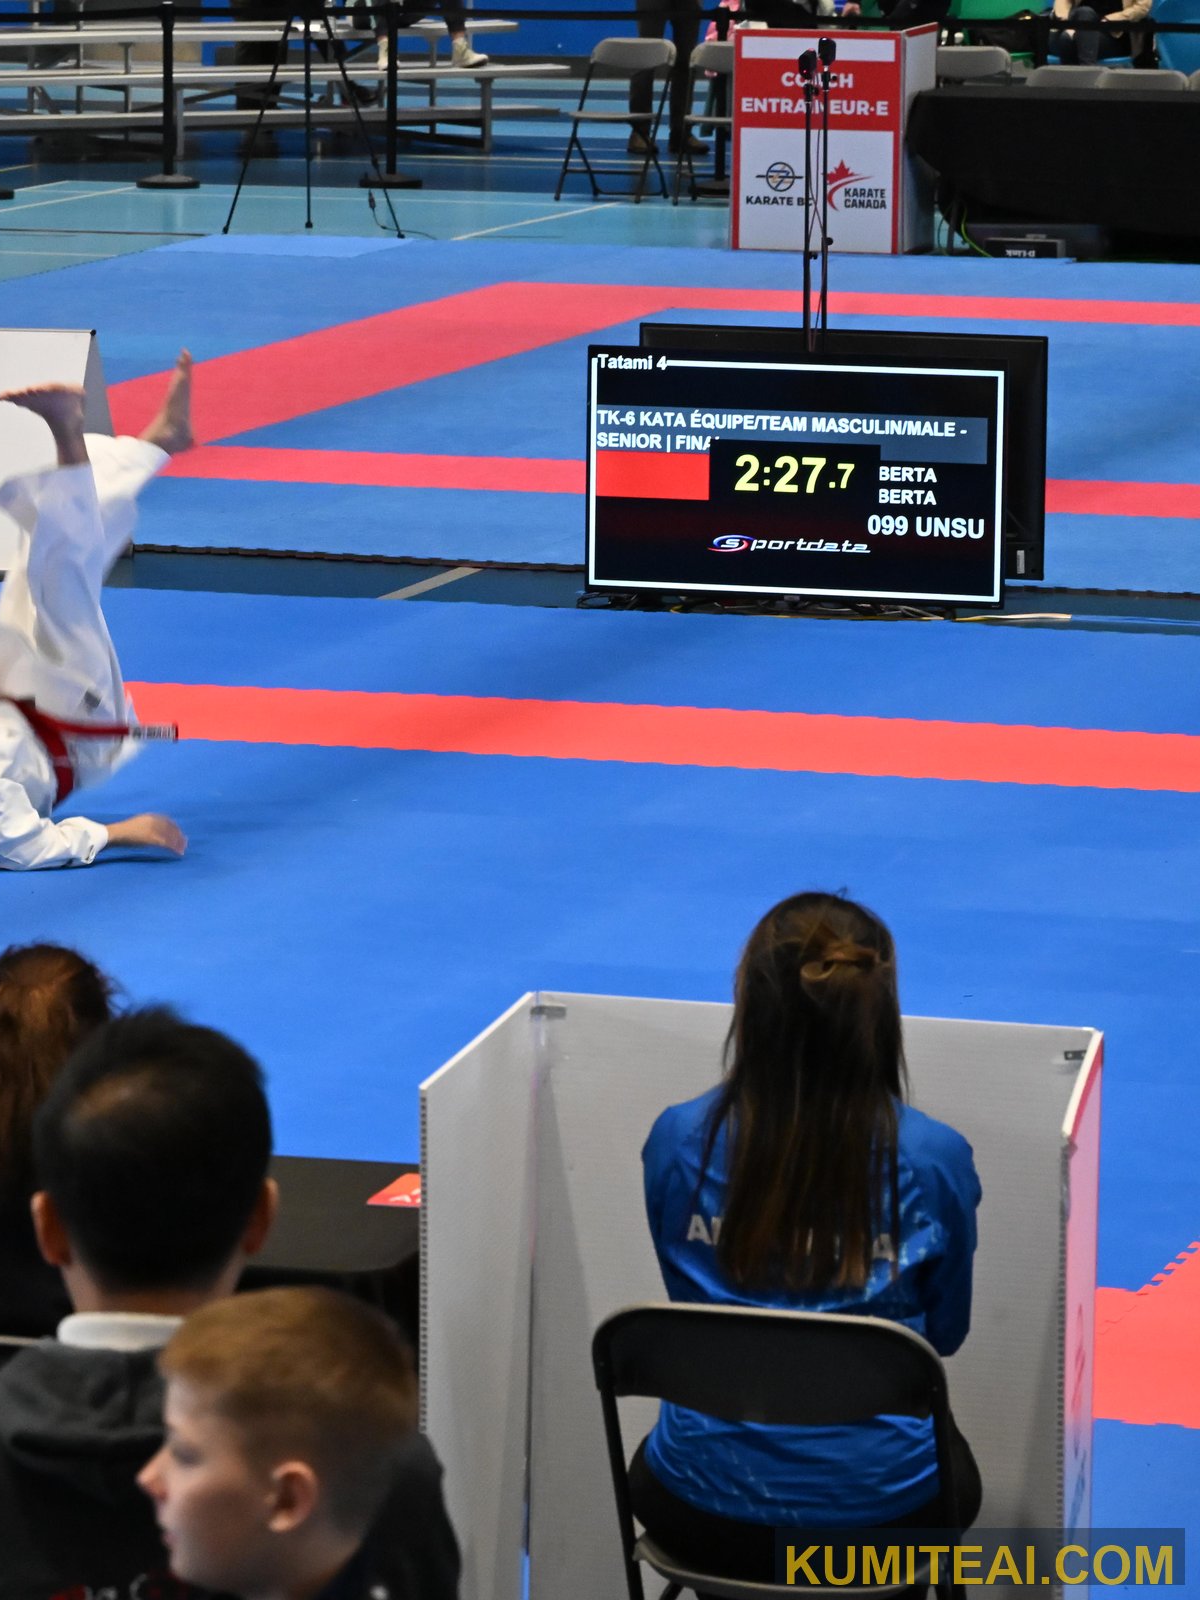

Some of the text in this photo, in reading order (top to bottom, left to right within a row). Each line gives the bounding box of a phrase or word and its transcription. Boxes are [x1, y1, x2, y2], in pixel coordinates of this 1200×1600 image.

[745, 195, 794, 207] KARATE
[844, 188, 886, 199] KARATE
[844, 199, 887, 210] CANADA
[597, 354, 669, 371] Tatami 4
[597, 409, 636, 427] TK-6
[639, 411, 686, 428] KATA
[690, 409, 808, 432] ÉQUIPE/TEAM
[811, 416, 956, 437] MASCULIN/MALE
[596, 432, 662, 449] SENIOR
[675, 435, 719, 451] FINA
[734, 454, 855, 494] 2:27.7
[878, 466, 938, 484] BERTA
[878, 489, 937, 506] BERTA
[867, 514, 985, 539] 099 UNSU
